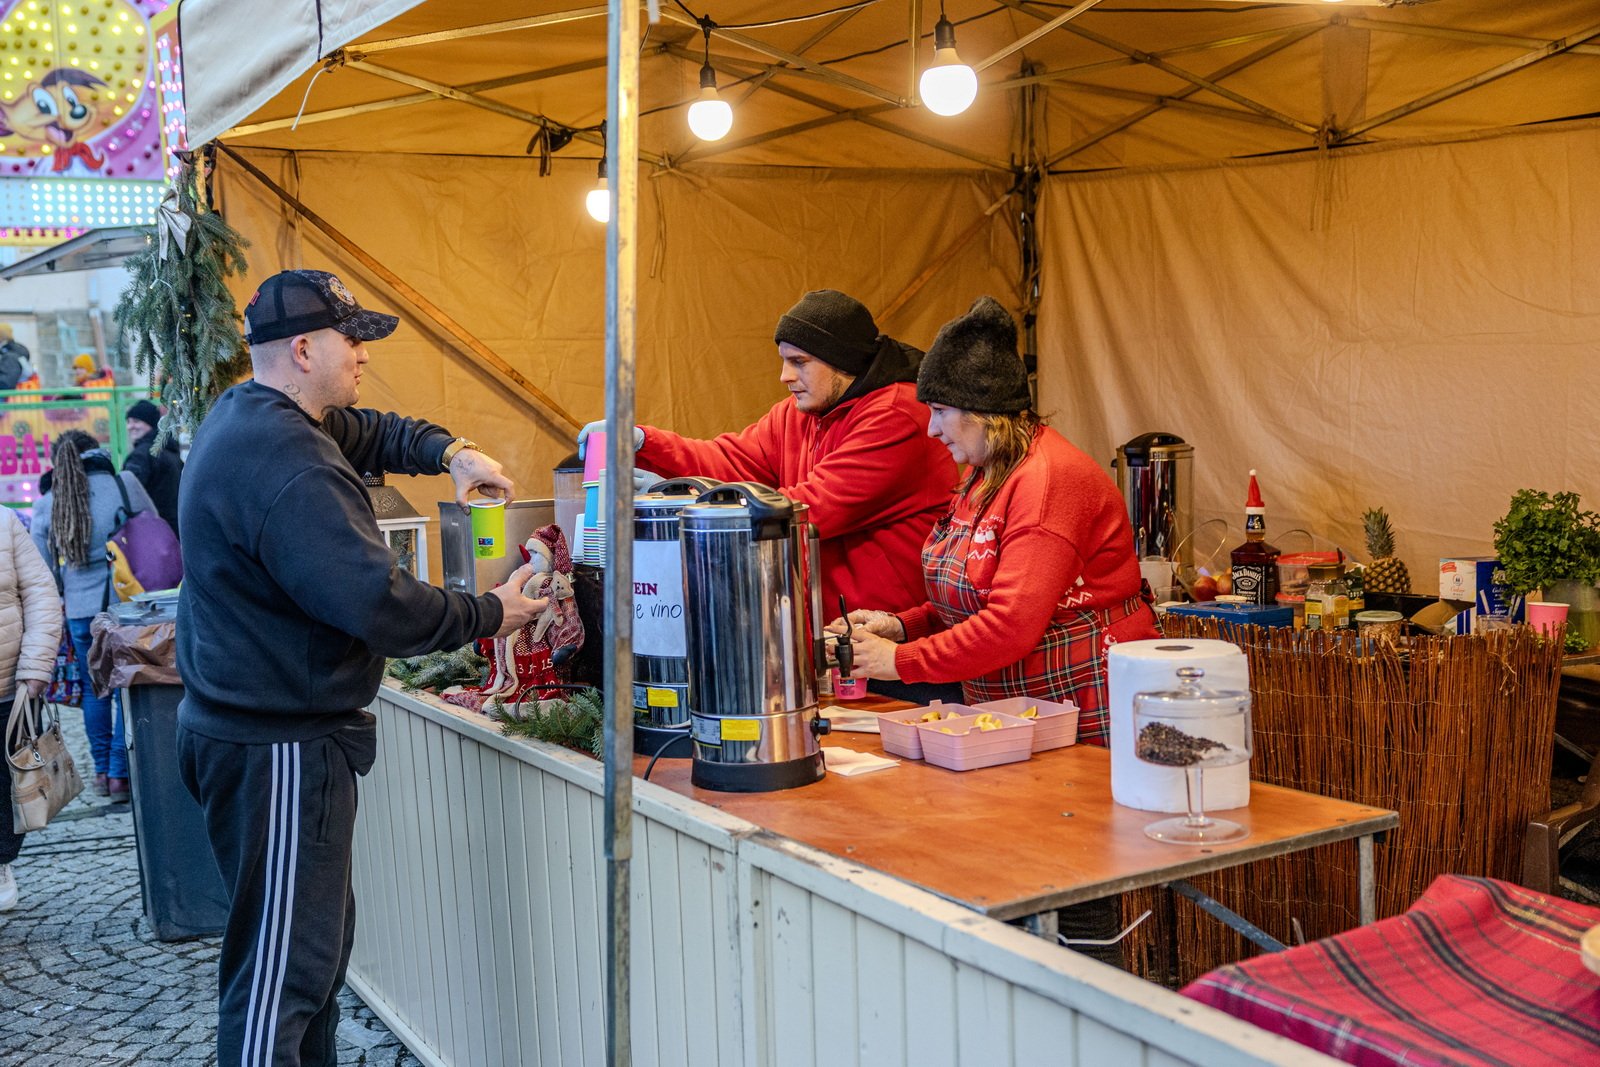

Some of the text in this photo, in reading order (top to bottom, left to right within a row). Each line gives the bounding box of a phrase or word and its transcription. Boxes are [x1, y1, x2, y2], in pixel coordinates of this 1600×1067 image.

[632, 582, 658, 596] EIN
[650, 599, 682, 619] vino
[541, 658, 554, 671] 15
